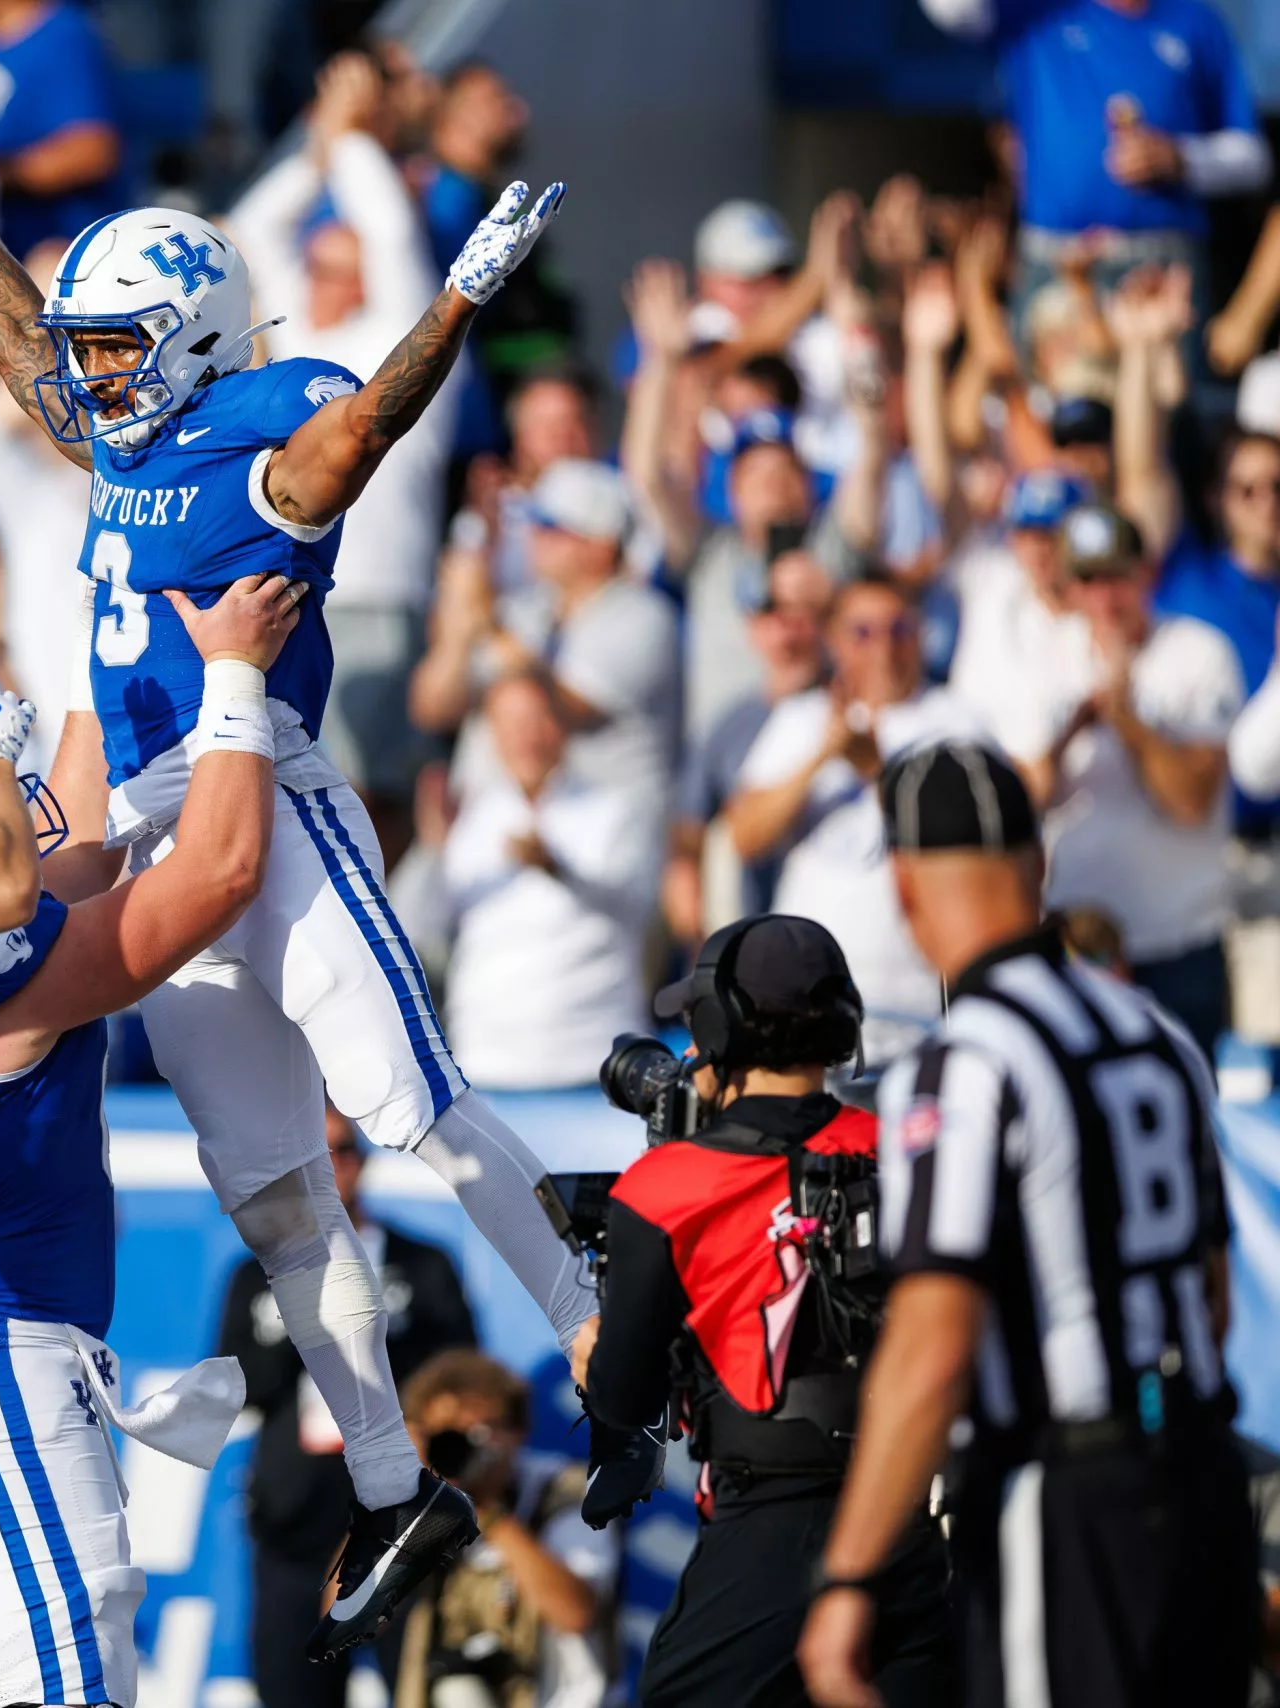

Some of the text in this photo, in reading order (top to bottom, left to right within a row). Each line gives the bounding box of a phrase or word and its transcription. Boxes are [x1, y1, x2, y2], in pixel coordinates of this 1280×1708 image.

[140, 231, 226, 297] UK
[91, 529, 150, 667] 3
[1090, 1052, 1200, 1266] B
